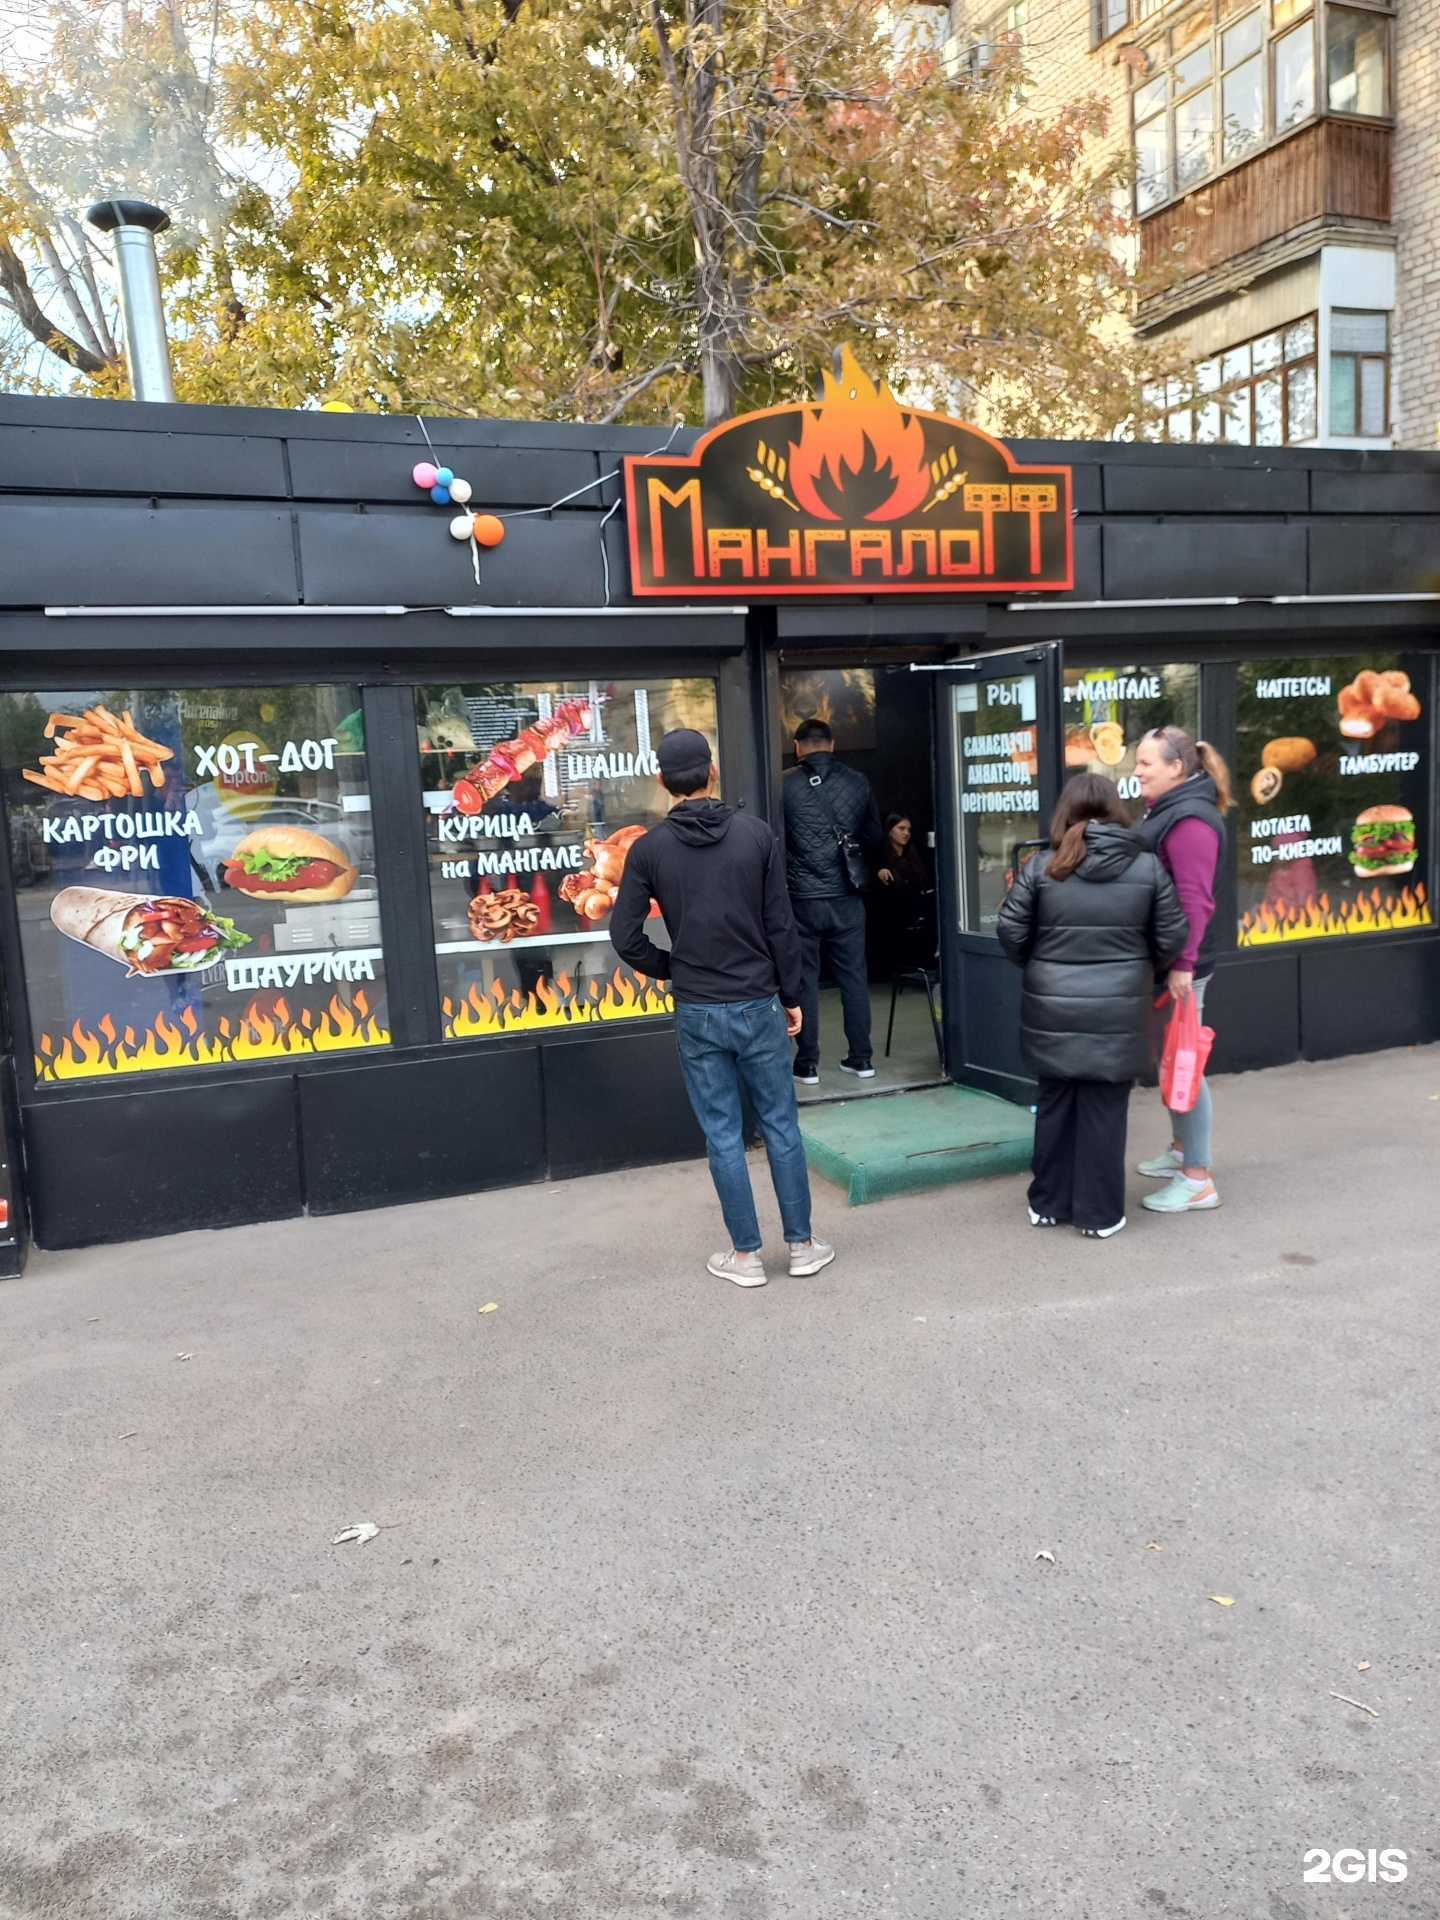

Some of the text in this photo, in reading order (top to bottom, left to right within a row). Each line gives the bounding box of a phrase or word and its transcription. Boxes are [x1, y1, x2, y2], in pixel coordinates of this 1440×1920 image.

[1076, 677, 1161, 702] МАНГАЛЕ
[1256, 676, 1331, 698] НАГГЕТСЫ
[193, 738, 338, 777] ХОТ-ДОГ
[1339, 751, 1420, 775] ГАМБУРГЕР
[42, 810, 204, 843] КАРТОШКА
[438, 813, 534, 842] КУРИЦА
[1251, 814, 1311, 838] КОТЛЕТА
[94, 845, 160, 872] ФРИ
[441, 845, 583, 879] на МАНГАЛЕ
[1251, 836, 1343, 864] ПО-КИЕВСКИ
[225, 957, 375, 992] ШАУРМА
